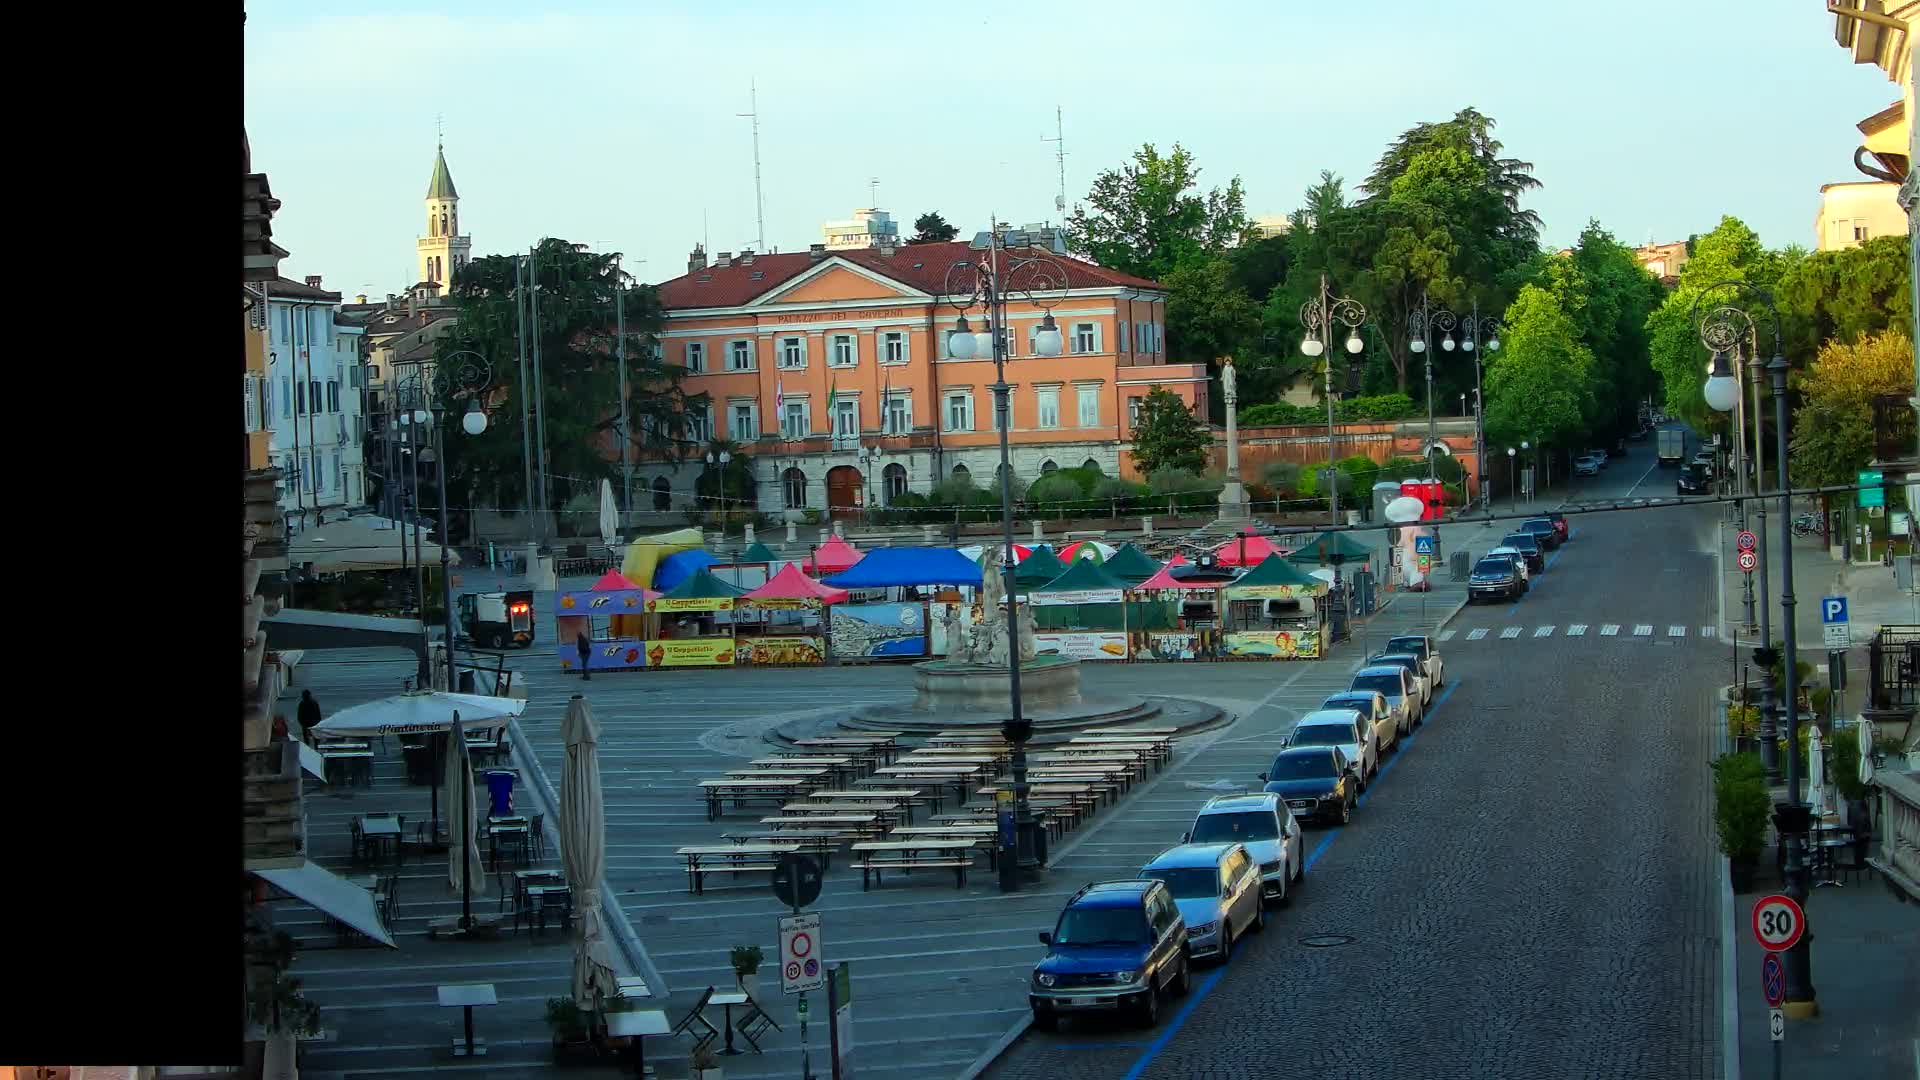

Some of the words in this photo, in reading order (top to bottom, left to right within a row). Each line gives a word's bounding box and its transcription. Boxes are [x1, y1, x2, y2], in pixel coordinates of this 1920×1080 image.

[1742, 556, 1752, 565] 20
[1829, 600, 1842, 620] P
[1762, 910, 1792, 936] 30
[789, 966, 798, 976] 20
